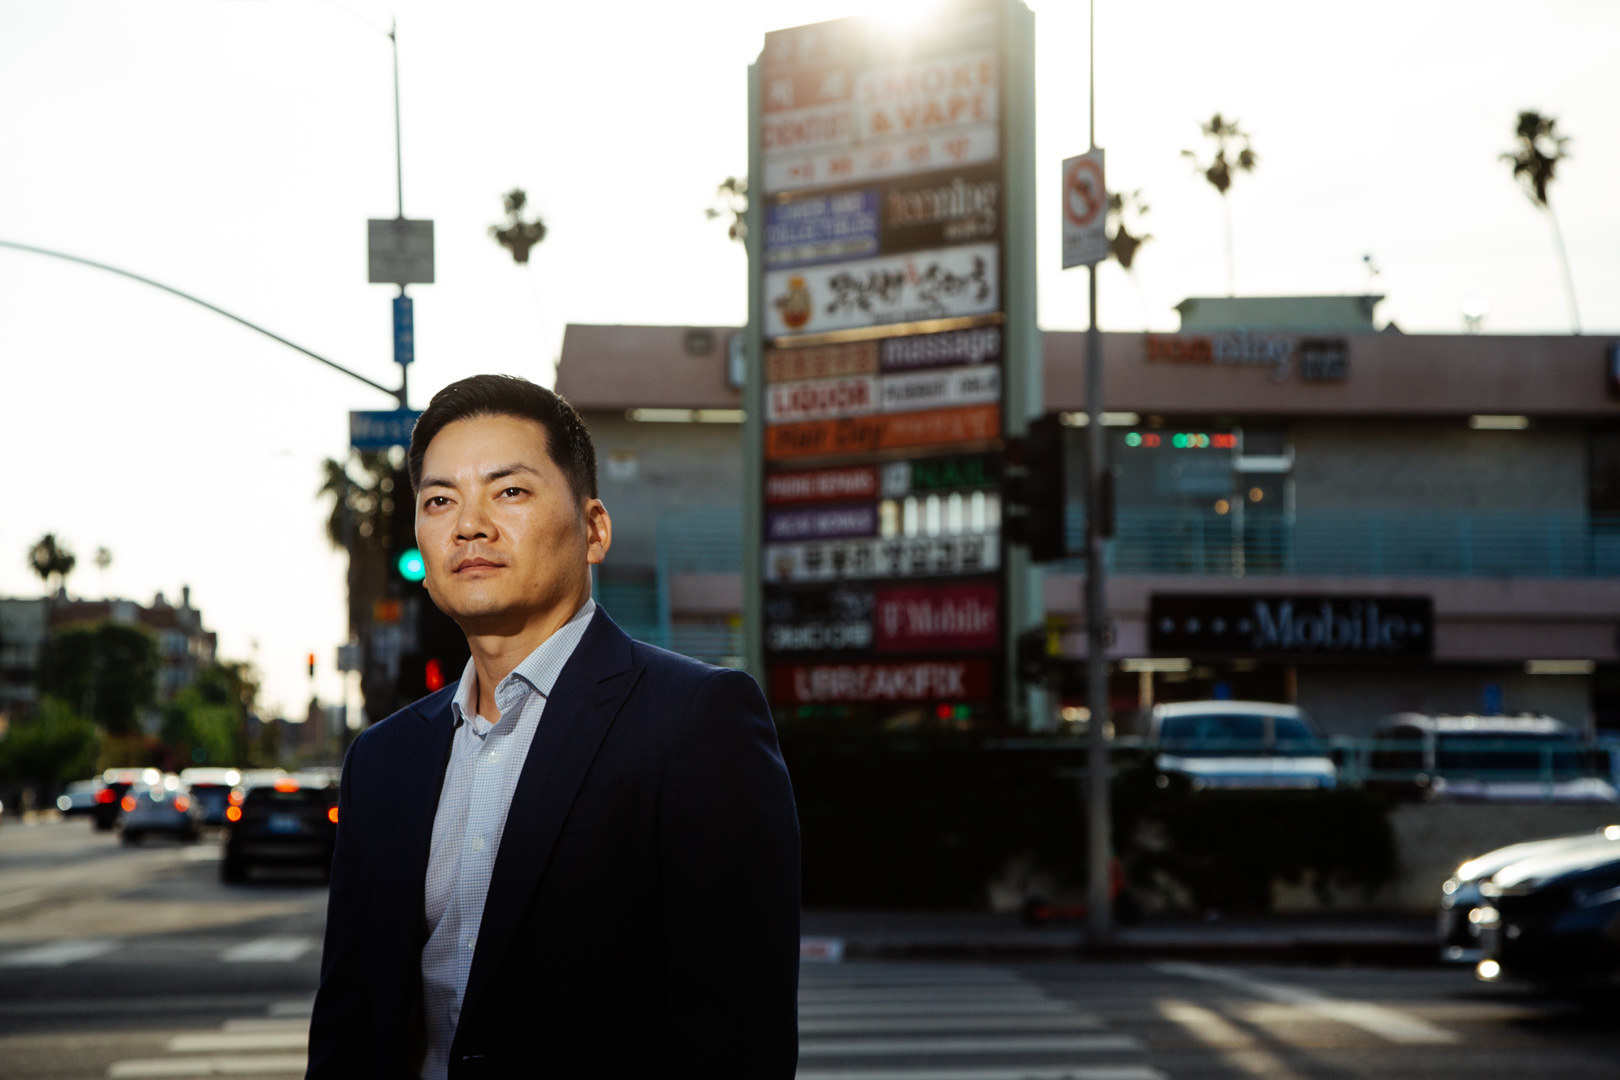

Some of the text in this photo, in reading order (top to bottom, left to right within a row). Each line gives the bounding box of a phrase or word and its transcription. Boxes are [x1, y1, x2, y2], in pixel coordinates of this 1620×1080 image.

[862, 60, 994, 102] SMOKE
[898, 90, 986, 130] VAPE
[889, 327, 1000, 365] massage
[772, 380, 871, 416] LIQUOR
[1253, 601, 1406, 650] Mobile
